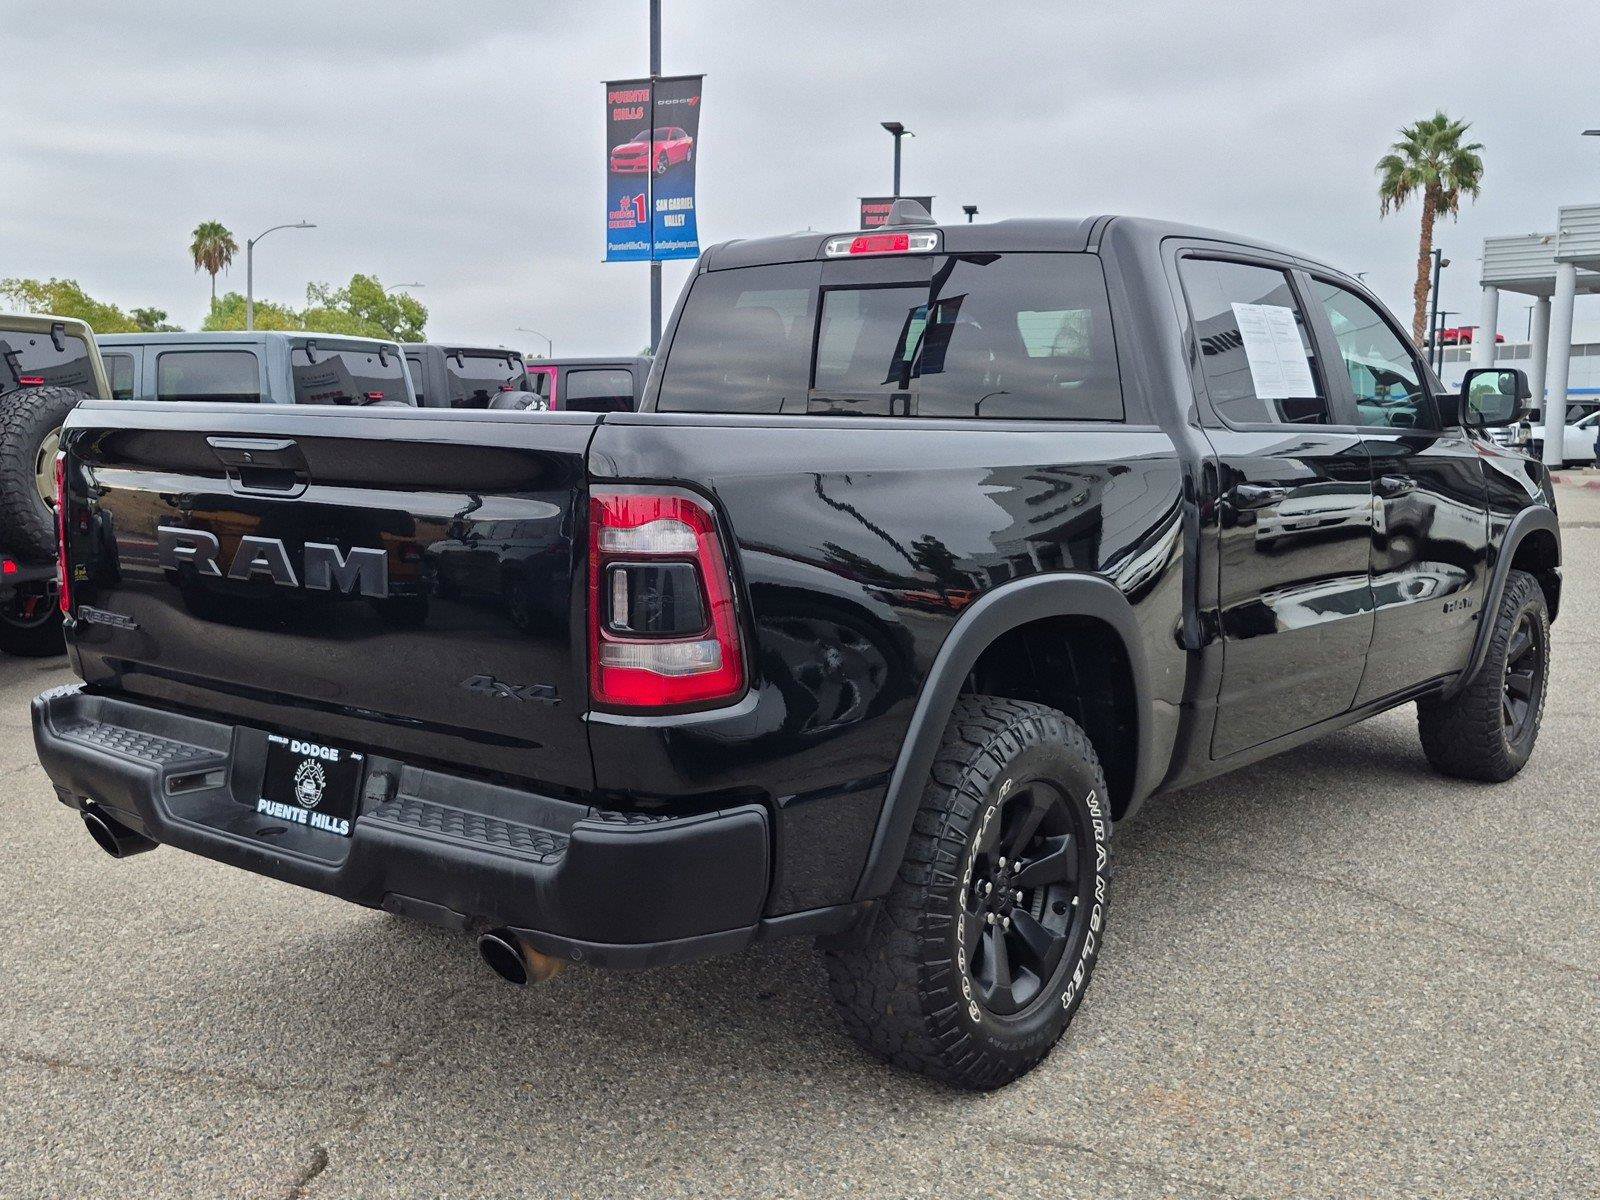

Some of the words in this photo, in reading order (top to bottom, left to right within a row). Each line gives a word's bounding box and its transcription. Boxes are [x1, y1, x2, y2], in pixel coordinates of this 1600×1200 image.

[608, 89, 650, 104] PUENTE
[613, 106, 644, 121] HILLS
[656, 199, 668, 212] SAN
[669, 197, 693, 210] GABRIEL
[664, 214, 686, 227] VALLEY
[157, 525, 389, 599] RAM
[290, 739, 339, 762] DODGE
[257, 799, 309, 825] PUENTE
[311, 812, 350, 836] HILLS
[1061, 789, 1108, 1010] WRANGLER
